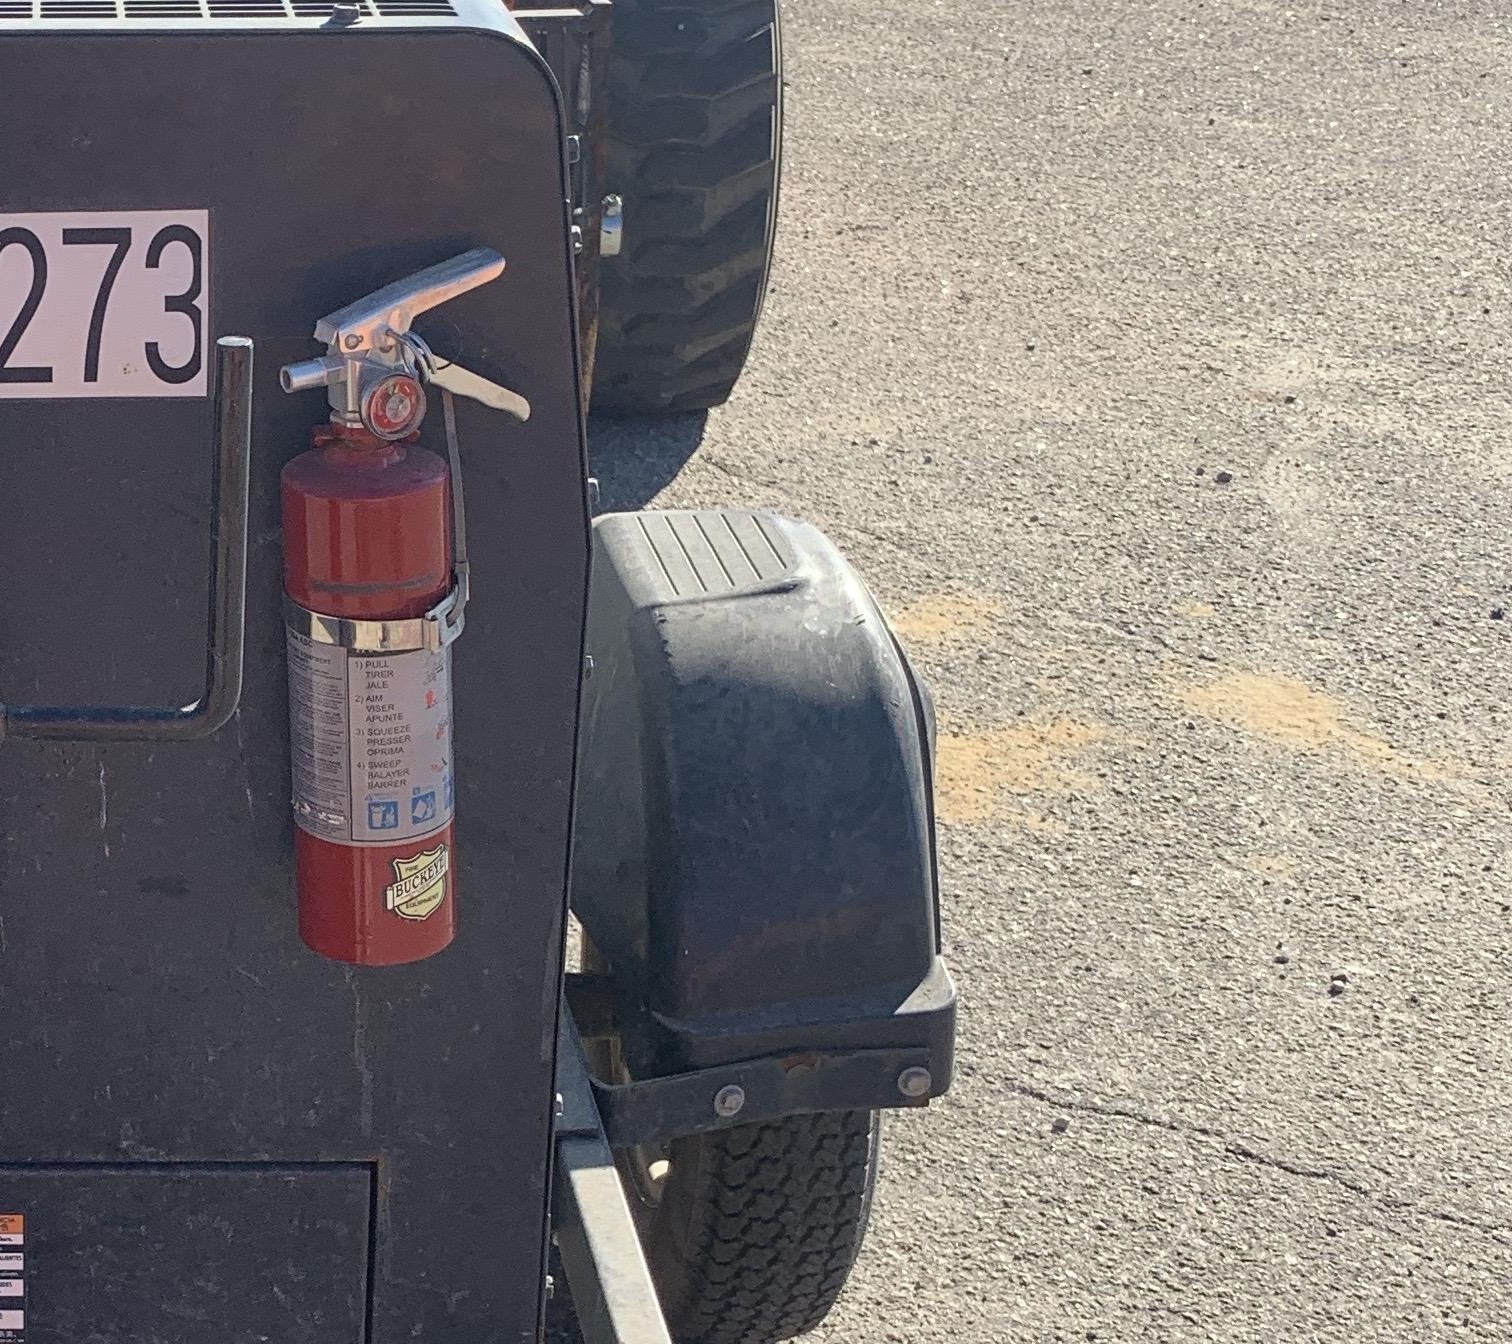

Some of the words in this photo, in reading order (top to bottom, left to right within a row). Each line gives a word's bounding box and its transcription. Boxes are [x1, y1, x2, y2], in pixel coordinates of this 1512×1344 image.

[365, 661, 390, 669] PULL
[366, 670, 394, 679] TIRER
[365, 681, 388, 689] JALE
[366, 703, 395, 713] VISER
[365, 713, 403, 722] APUNTE
[367, 725, 411, 736] SQUEEZE
[367, 735, 411, 746] PRESSER
[367, 747, 404, 756] OPRIMA
[368, 759, 401, 769] SWEEP
[368, 768, 409, 779] BALAYER
[368, 779, 407, 789] BARRER
[395, 855, 445, 897] BUCKEYE
